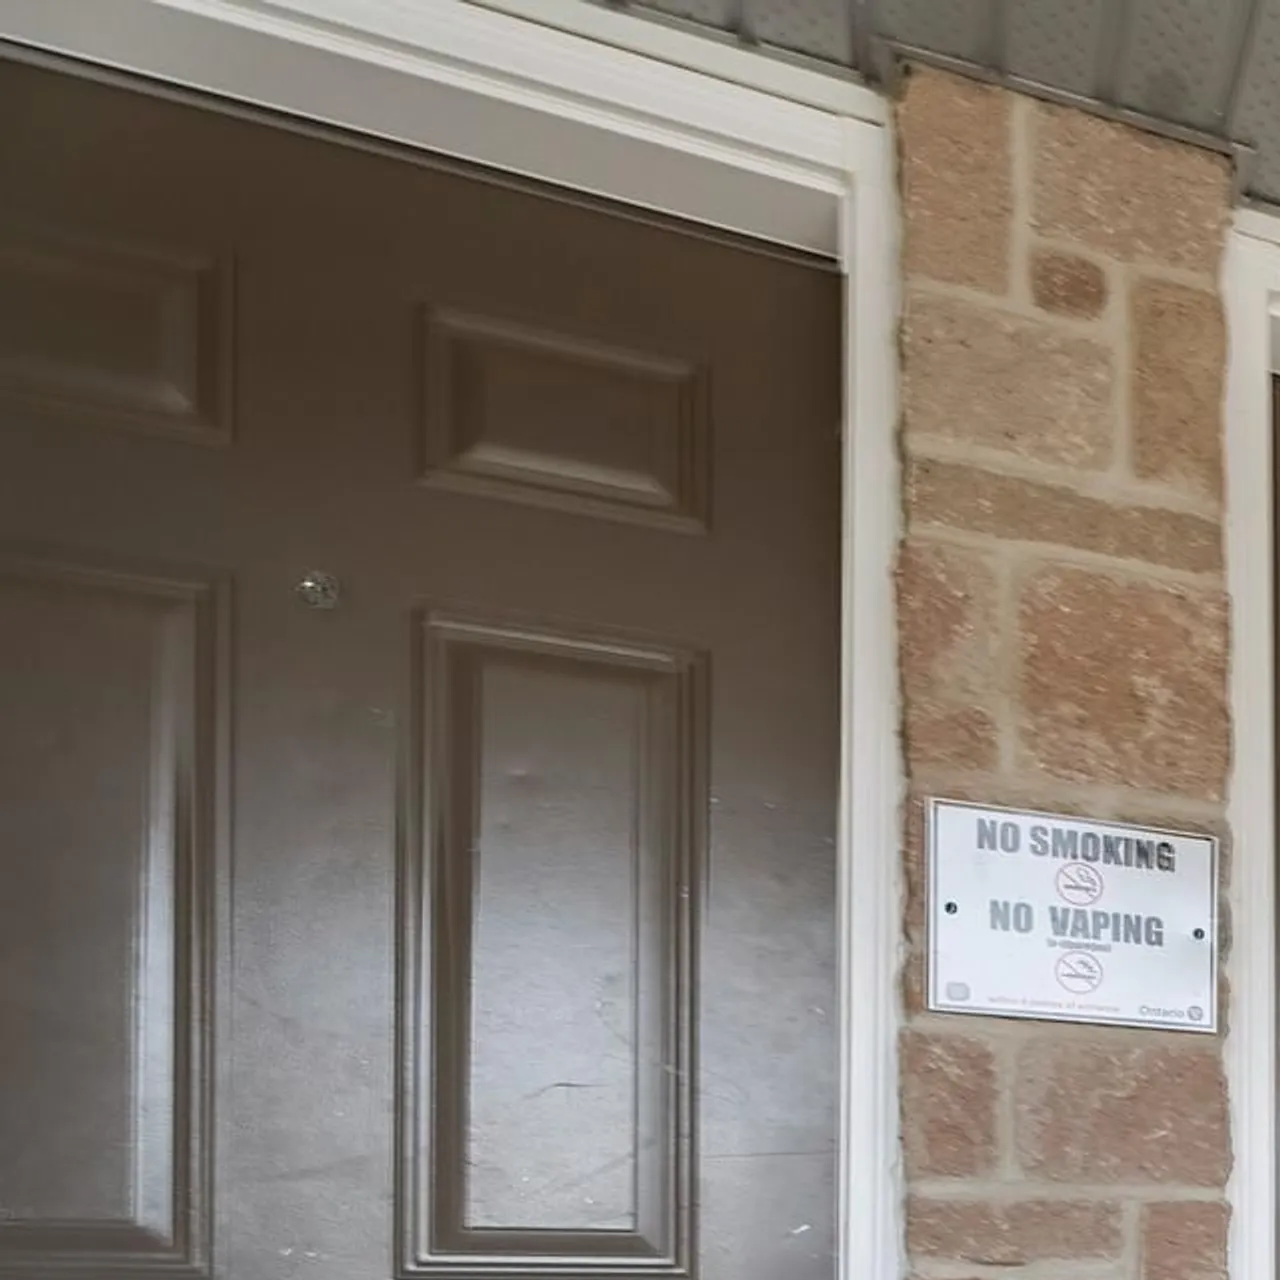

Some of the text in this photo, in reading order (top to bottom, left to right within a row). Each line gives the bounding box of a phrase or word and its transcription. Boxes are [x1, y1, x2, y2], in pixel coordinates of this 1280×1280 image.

[976, 818, 1176, 873] NO SMOKING
[989, 899, 1034, 934] NO
[1048, 905, 1164, 947] VAPING
[1138, 1004, 1185, 1018] Ontario
